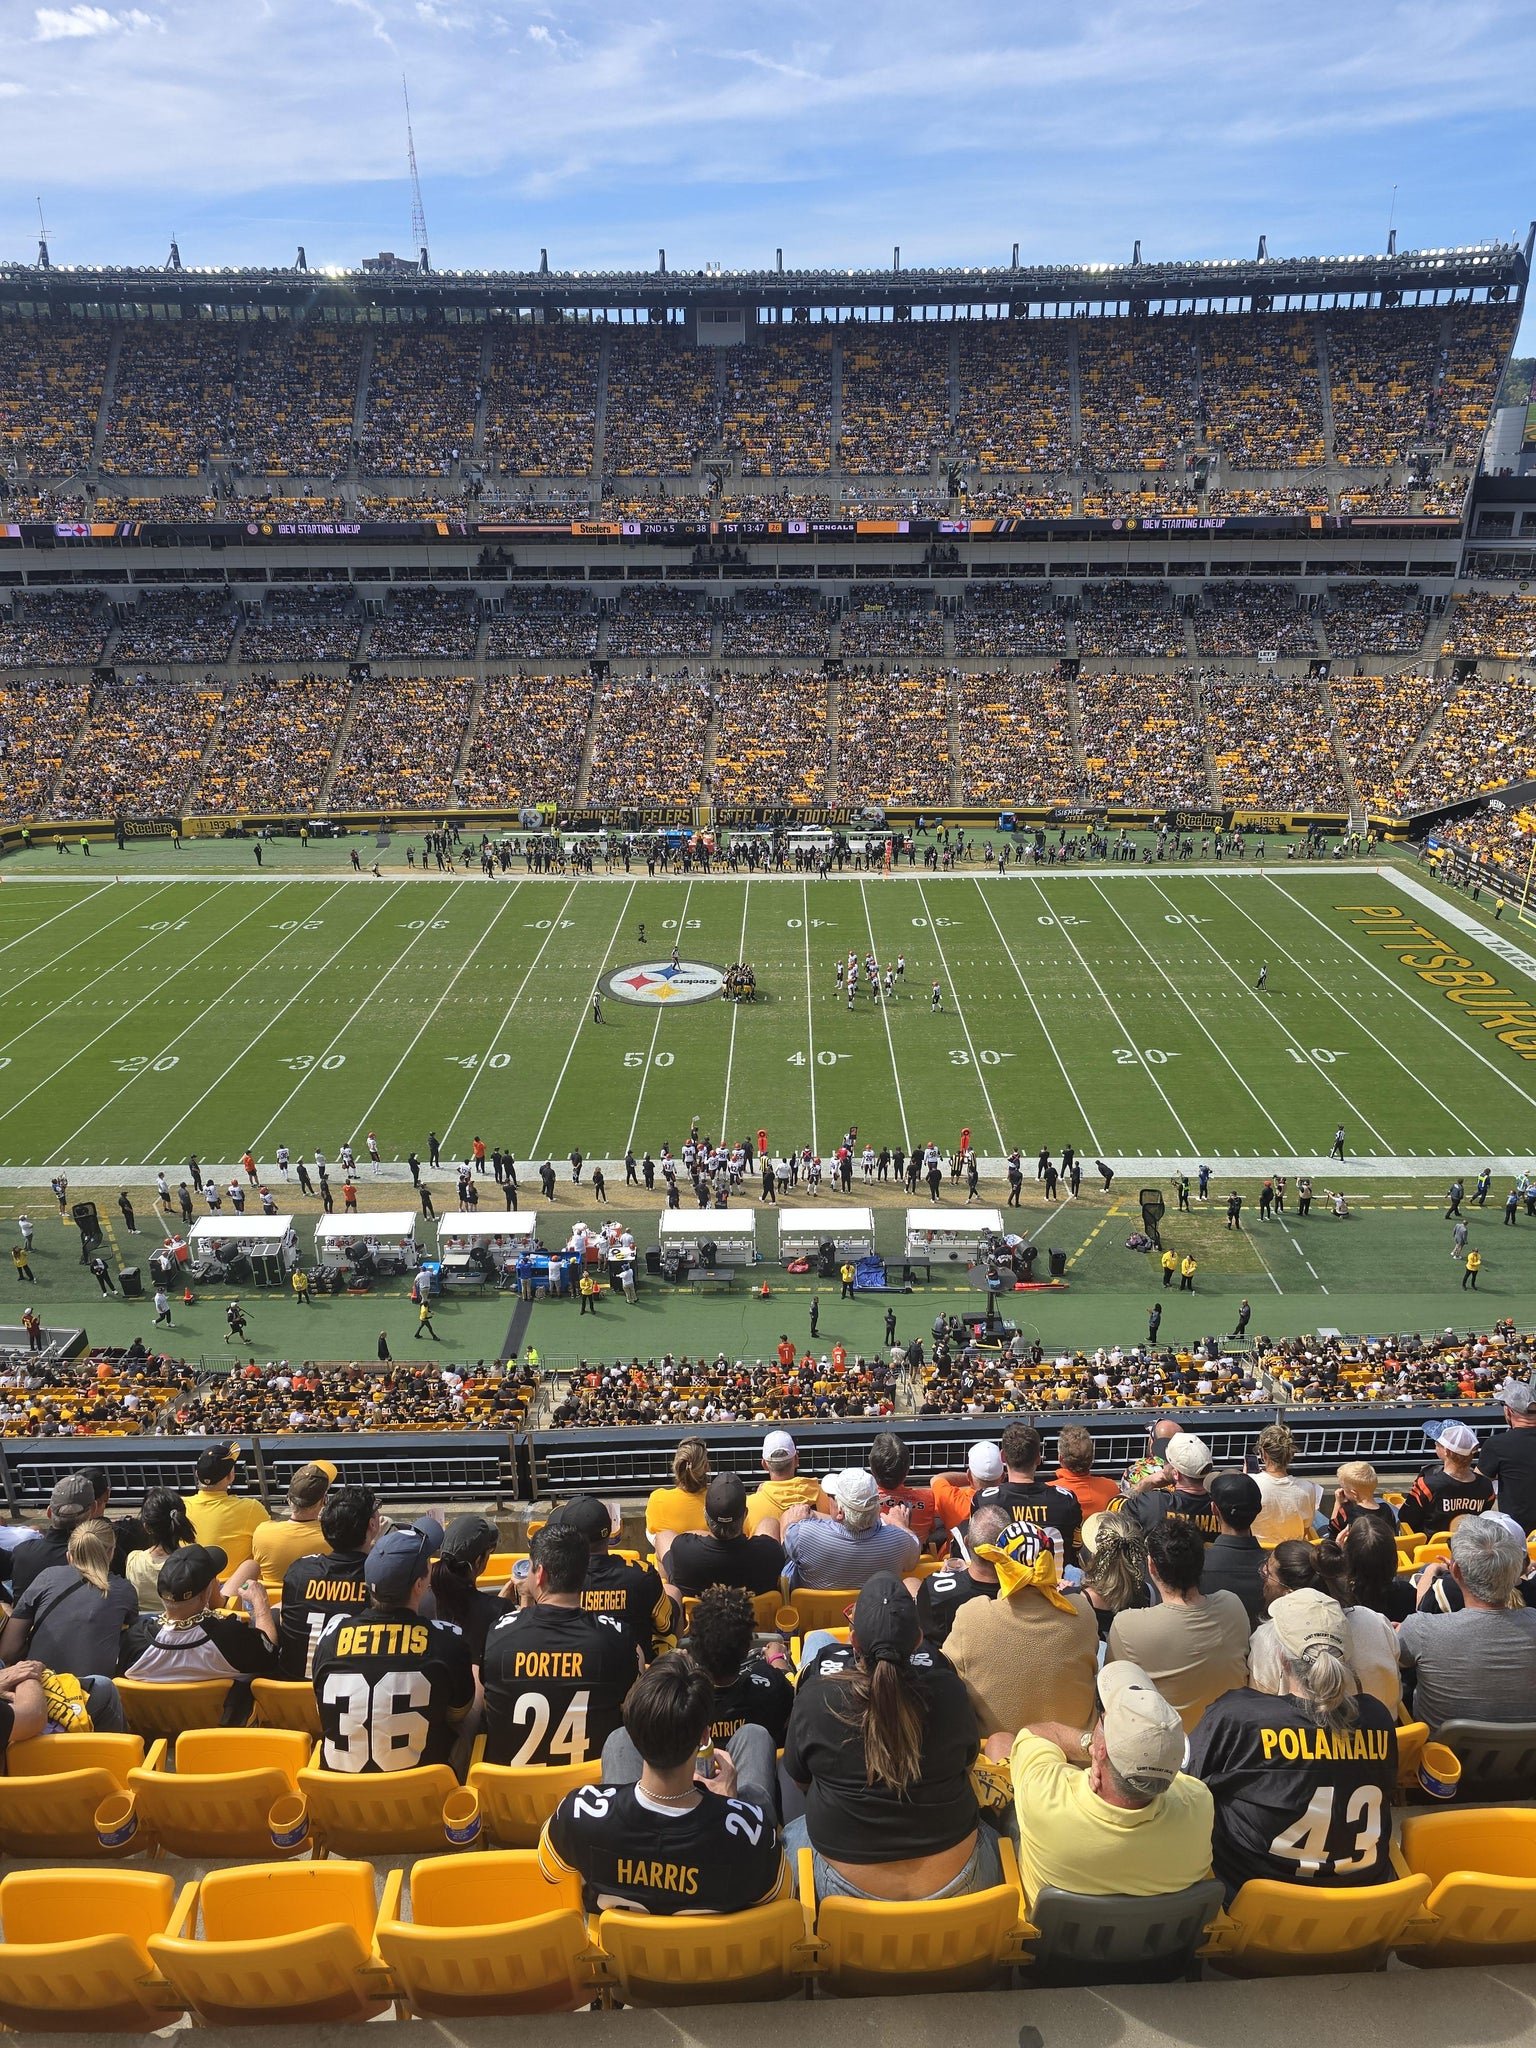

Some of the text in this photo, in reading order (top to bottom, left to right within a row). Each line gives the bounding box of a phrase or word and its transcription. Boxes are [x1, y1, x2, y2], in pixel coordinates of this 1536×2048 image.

[278, 524, 361, 534] IBEW STARTING LINEUP
[580, 524, 635, 534] Steelers 0
[645, 525, 661, 533] 2ND
[670, 525, 675, 533] 5
[696, 525, 707, 533] 38
[742, 524, 764, 532] 13:47
[794, 523, 800, 532] 0
[1142, 519, 1160, 529] IBEW
[1162, 519, 1200, 529] STARTING
[1199, 518, 1226, 528] LINEUP
[1489, 799, 1507, 811] HEINZ
[638, 808, 690, 825] TEELERS
[1176, 812, 1224, 827] Steelers
[1259, 816, 1281, 826] 1933
[123, 821, 174, 836] Steelers
[209, 820, 231, 830] 1933
[278, 920, 324, 931] 20
[407, 919, 451, 930] 30
[534, 919, 576, 930] 40
[661, 918, 702, 930] 50
[786, 918, 827, 929] 40
[911, 917, 952, 928] 30
[1037, 915, 1080, 926] 20
[1165, 914, 1203, 925] 10
[1465, 928, 1536, 973] IT TAKES
[1332, 905, 1536, 1060] PITTSBUR
[117, 1055, 181, 1072] 20
[288, 1054, 347, 1071] 30
[456, 1052, 512, 1069] 40
[622, 1052, 676, 1068] 50
[786, 1050, 839, 1067] 40
[947, 1049, 1001, 1066] 30
[1111, 1048, 1169, 1065] 20
[1285, 1047, 1338, 1064] 10
[1153, 1386, 1164, 1396] 97
[1442, 1498, 1485, 1512] BURROW
[1012, 1505, 1047, 1522] WATT
[305, 1579, 366, 1602] DOWDLE
[336, 1624, 430, 1657] BETTIS
[514, 1651, 584, 1678] PORTER
[322, 1671, 432, 1773] 36
[510, 1690, 591, 1768] 24
[709, 1718, 746, 1738] ATRICK
[1260, 1727, 1389, 1761] POLAMALU
[572, 1783, 618, 1819] 22
[724, 1798, 764, 1847] 22
[1267, 1784, 1384, 1879] 43
[617, 1858, 699, 1896] HARRIS
